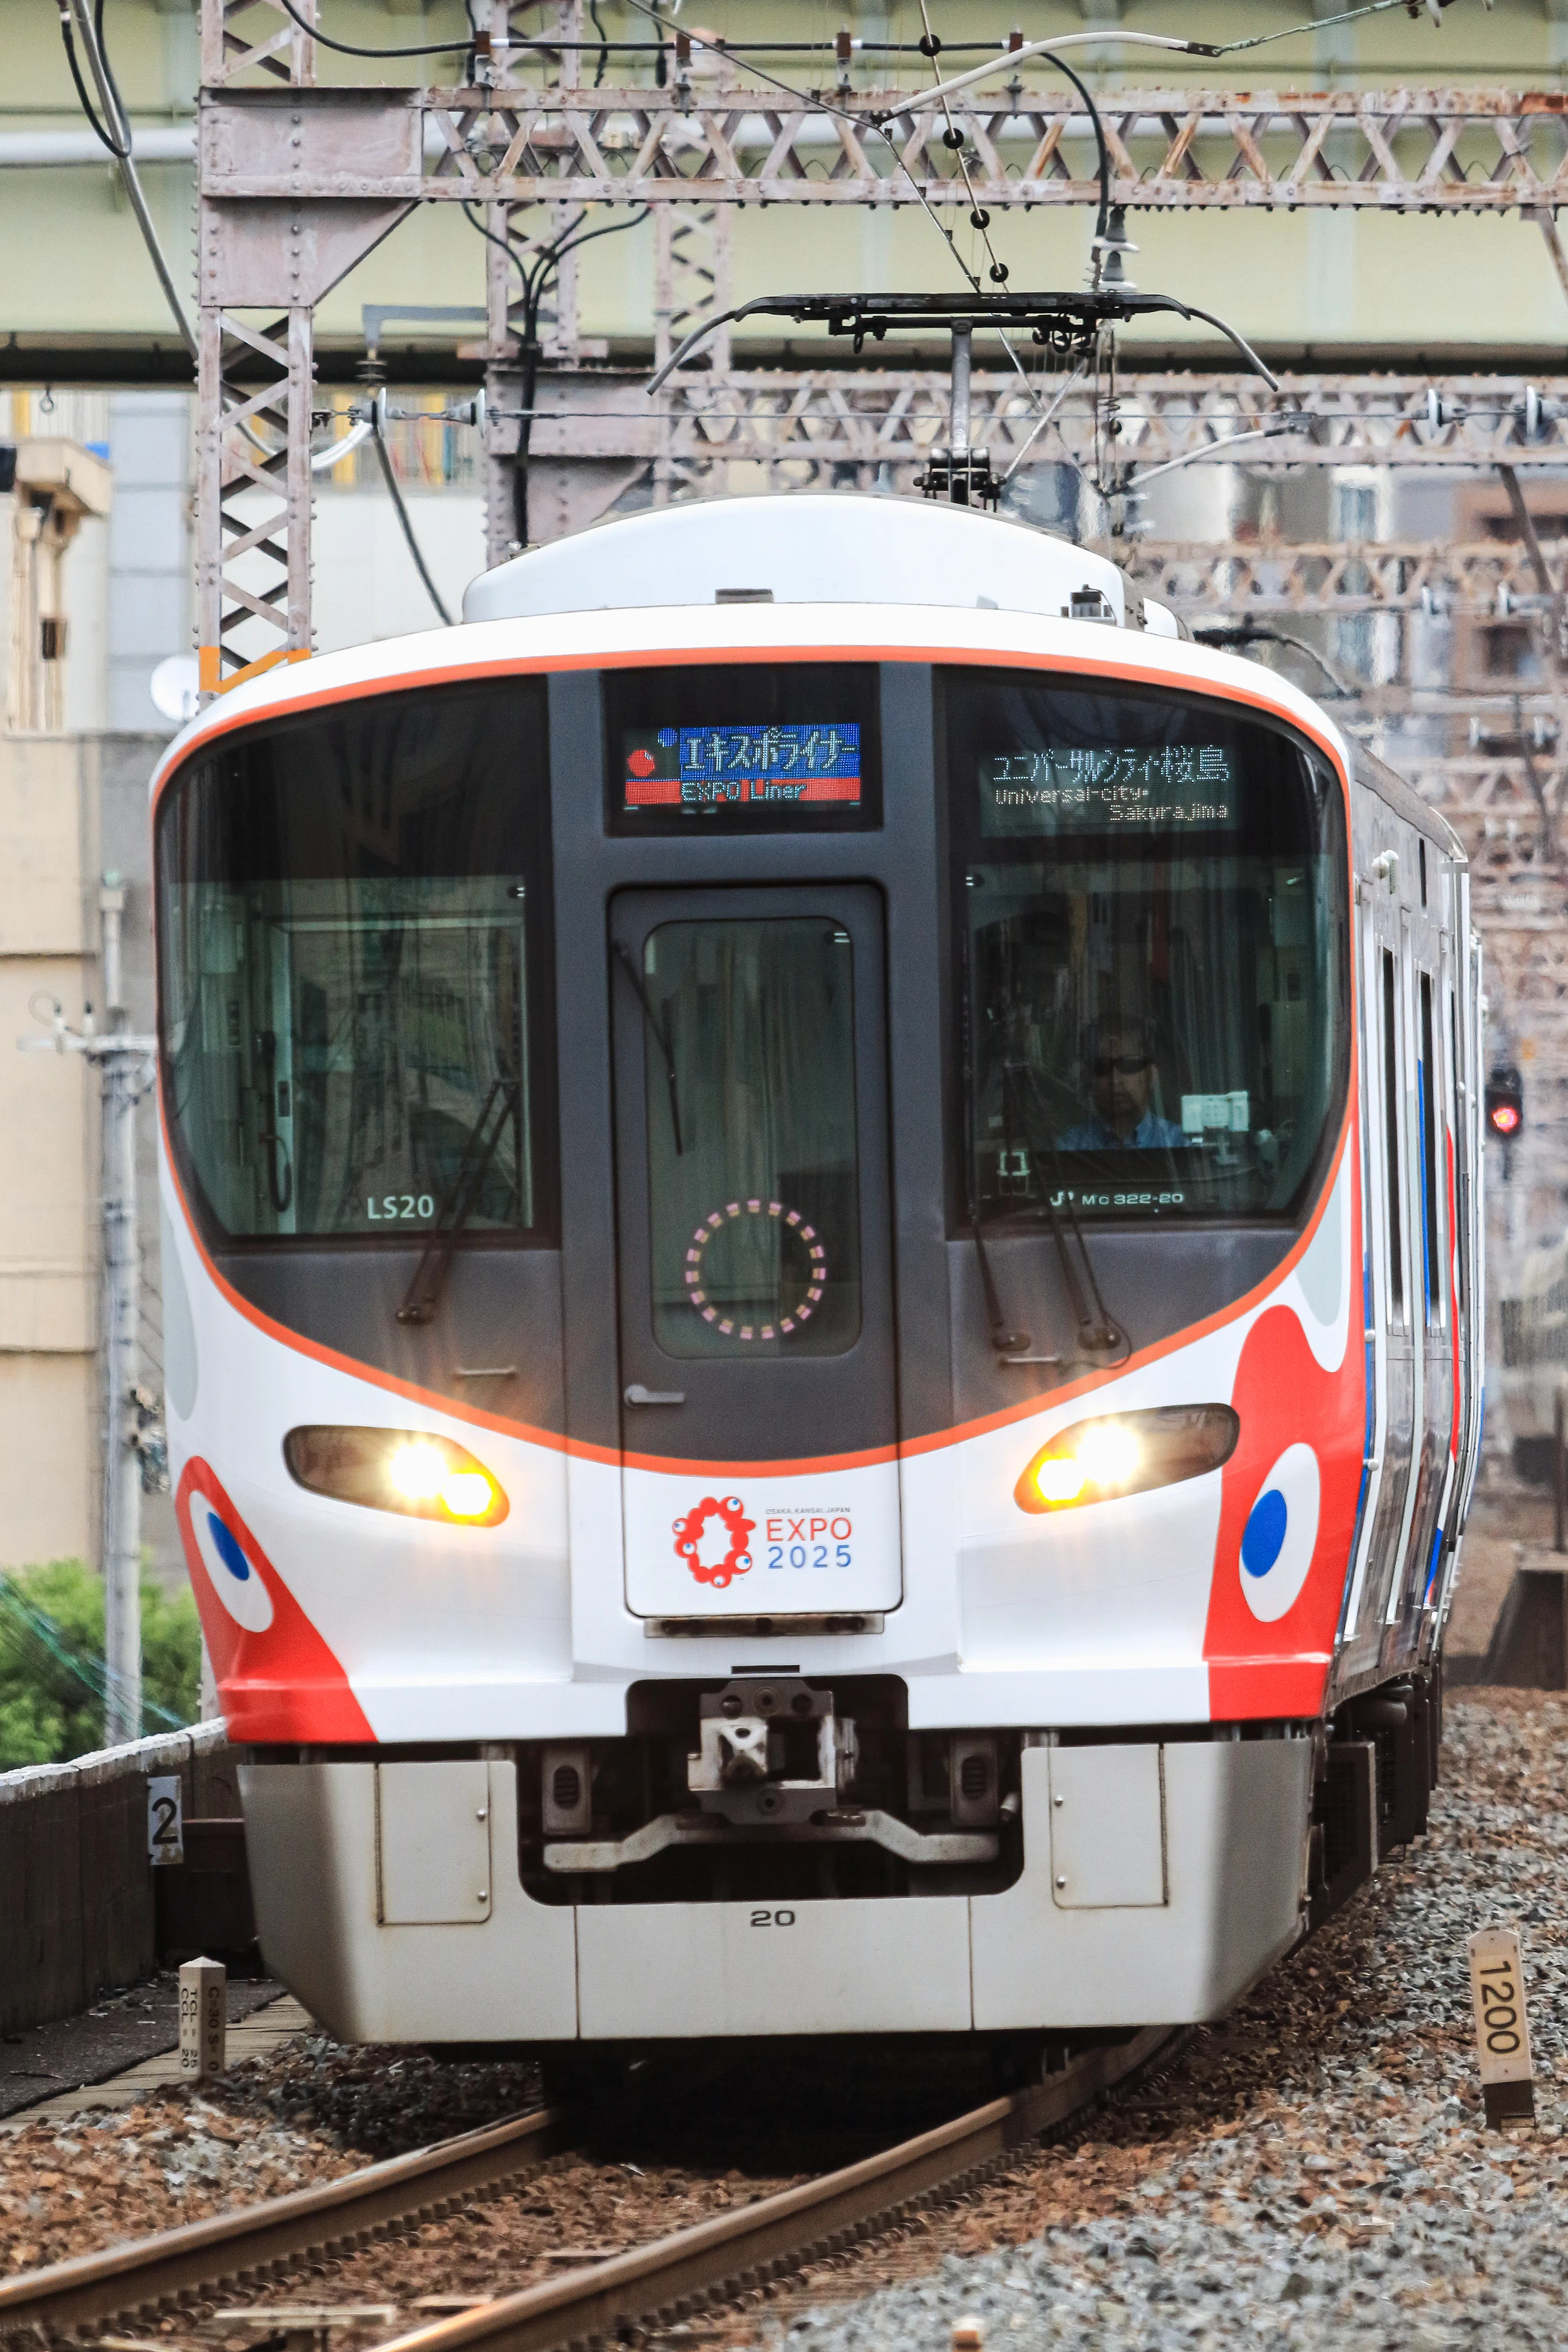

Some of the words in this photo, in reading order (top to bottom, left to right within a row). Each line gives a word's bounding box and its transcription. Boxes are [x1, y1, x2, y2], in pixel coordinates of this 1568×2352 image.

[684, 725, 857, 772] エキスポライナー
[681, 781, 740, 802] EXPO
[750, 780, 807, 800] Liner
[1110, 804, 1228, 821] Sakurajima
[367, 1195, 434, 1219] LS20
[1114, 1193, 1184, 1205] 322-20
[766, 1517, 852, 1542] EXPO
[768, 1545, 852, 1569] 2025
[151, 1797, 178, 1844] 2
[750, 1910, 795, 1927] 20
[1480, 1961, 1520, 2054] 1200
[181, 2049, 189, 2068] 20
